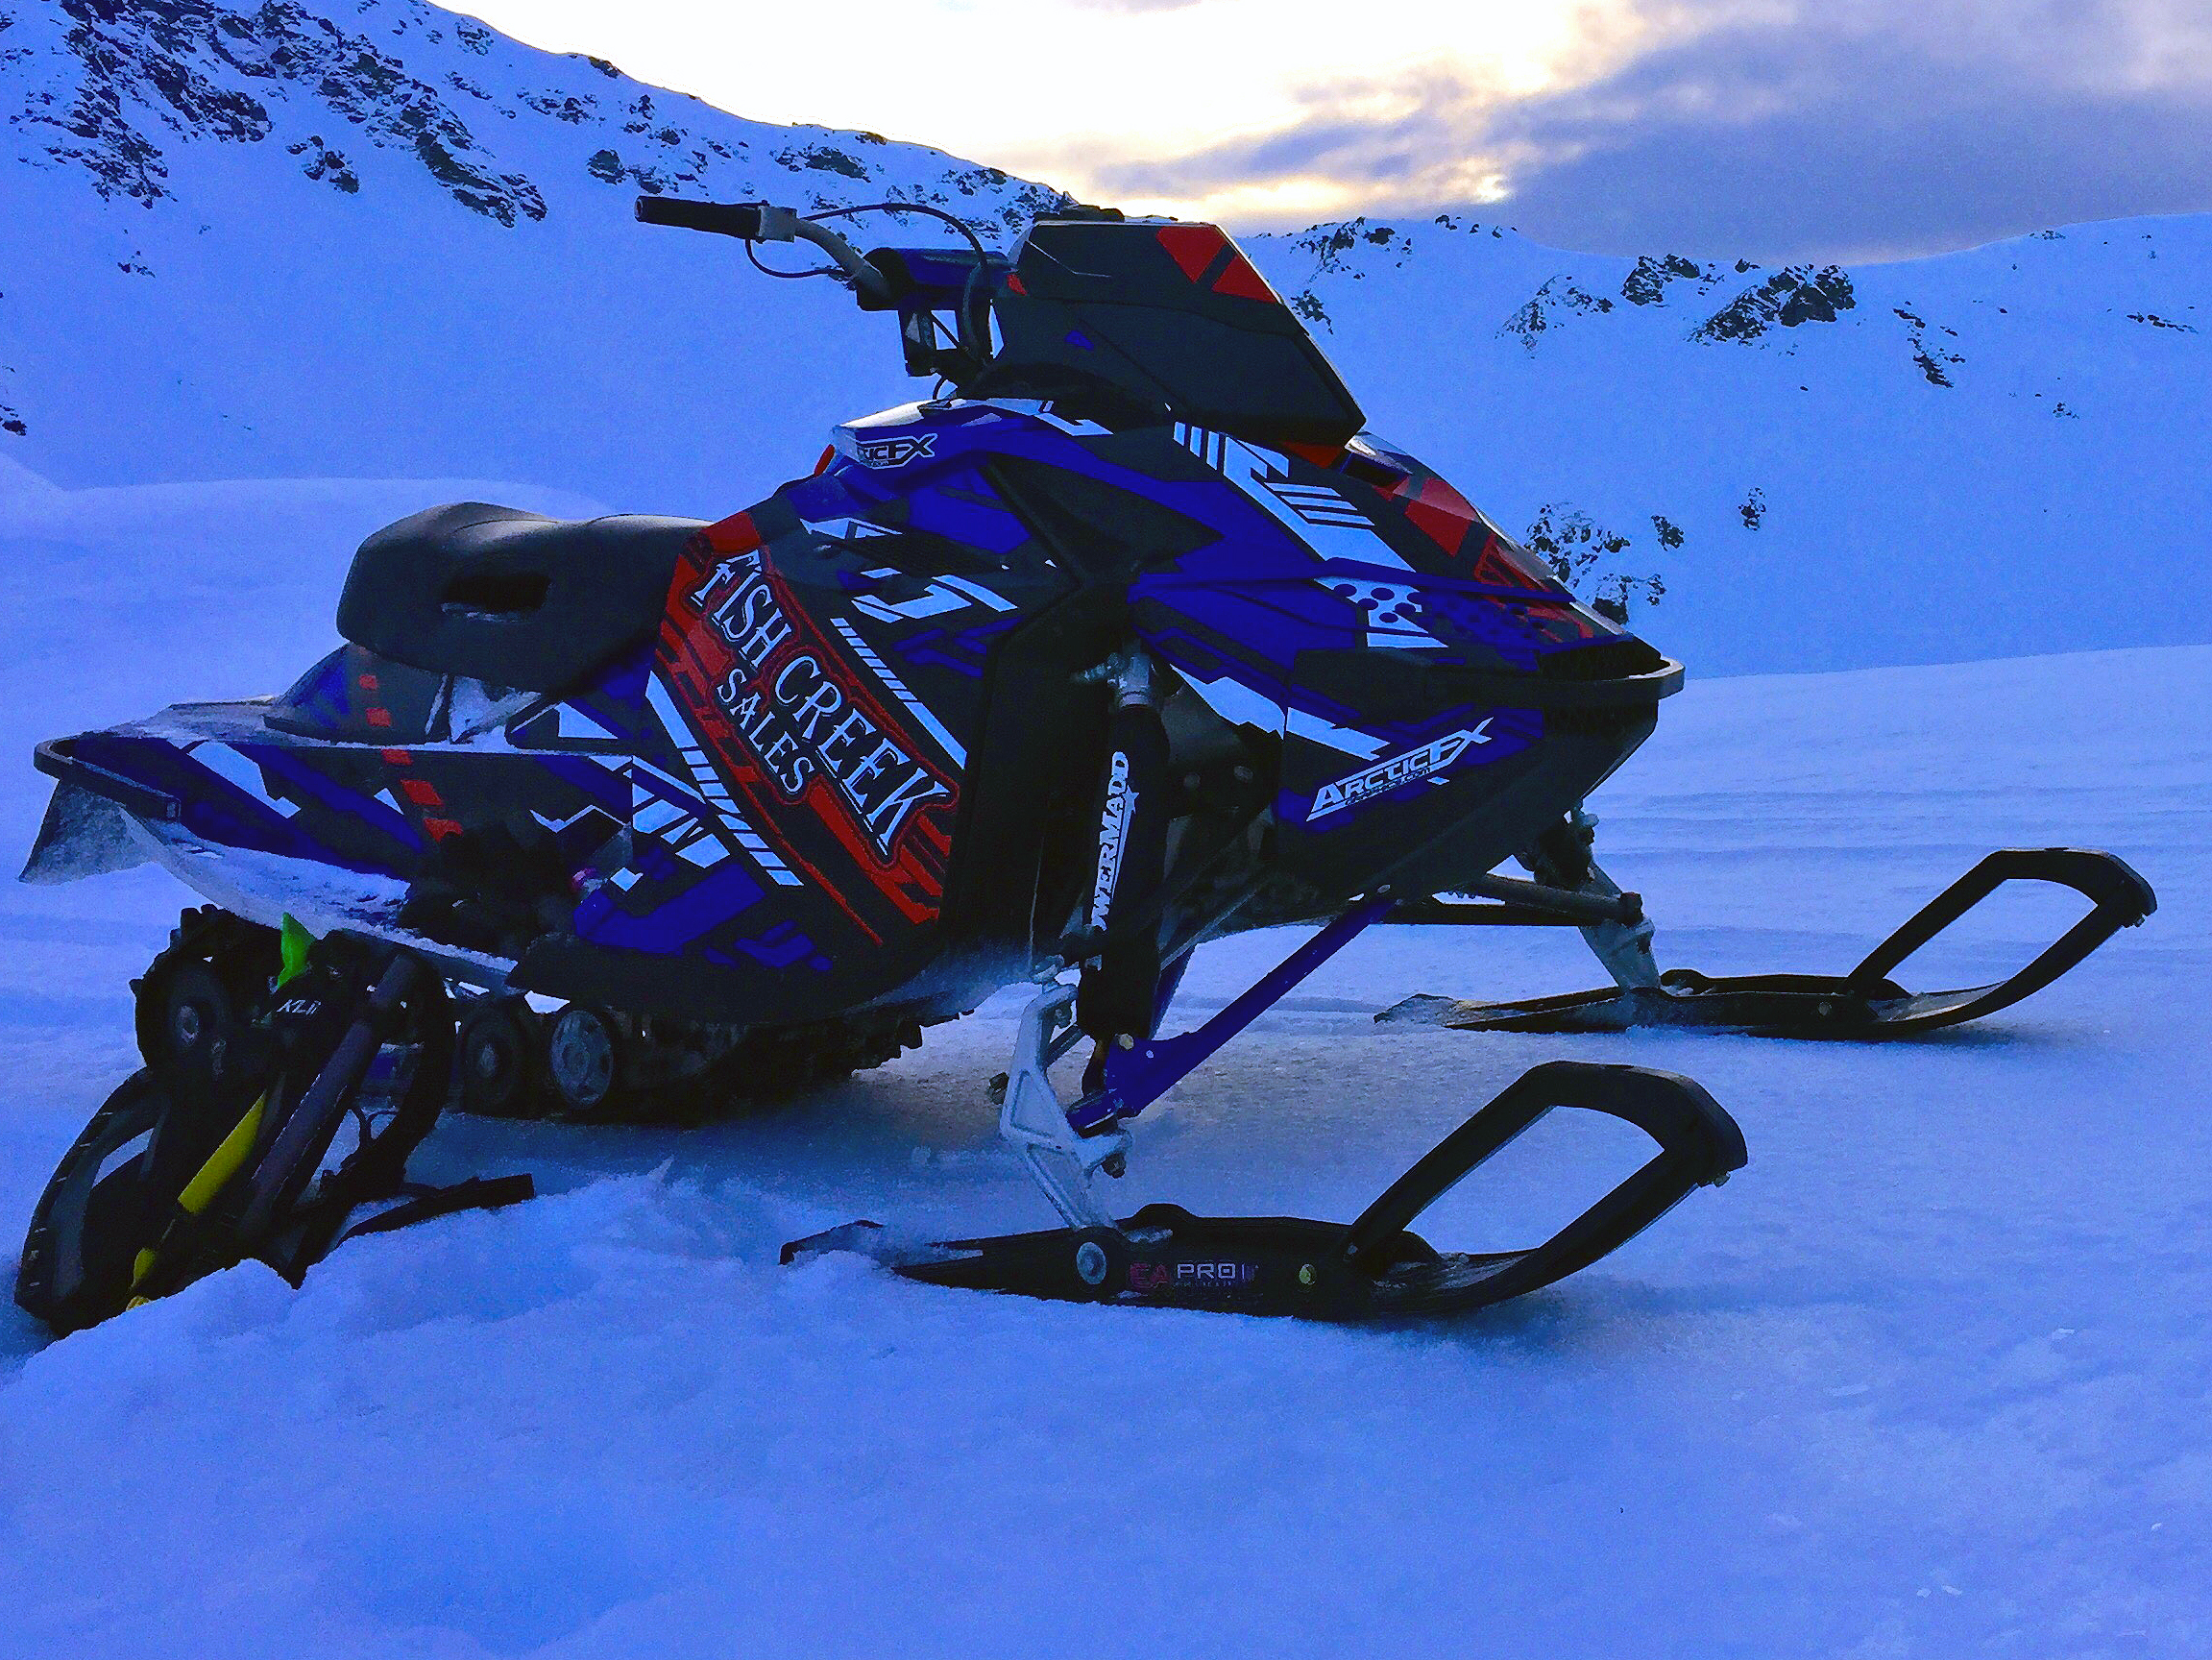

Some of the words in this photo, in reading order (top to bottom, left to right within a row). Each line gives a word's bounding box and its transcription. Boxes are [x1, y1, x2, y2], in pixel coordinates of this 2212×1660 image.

[691, 549, 792, 671] FISH
[774, 655, 951, 856] CREEK
[717, 668, 815, 794] SALES
[1177, 1263, 1236, 1279] PRO
